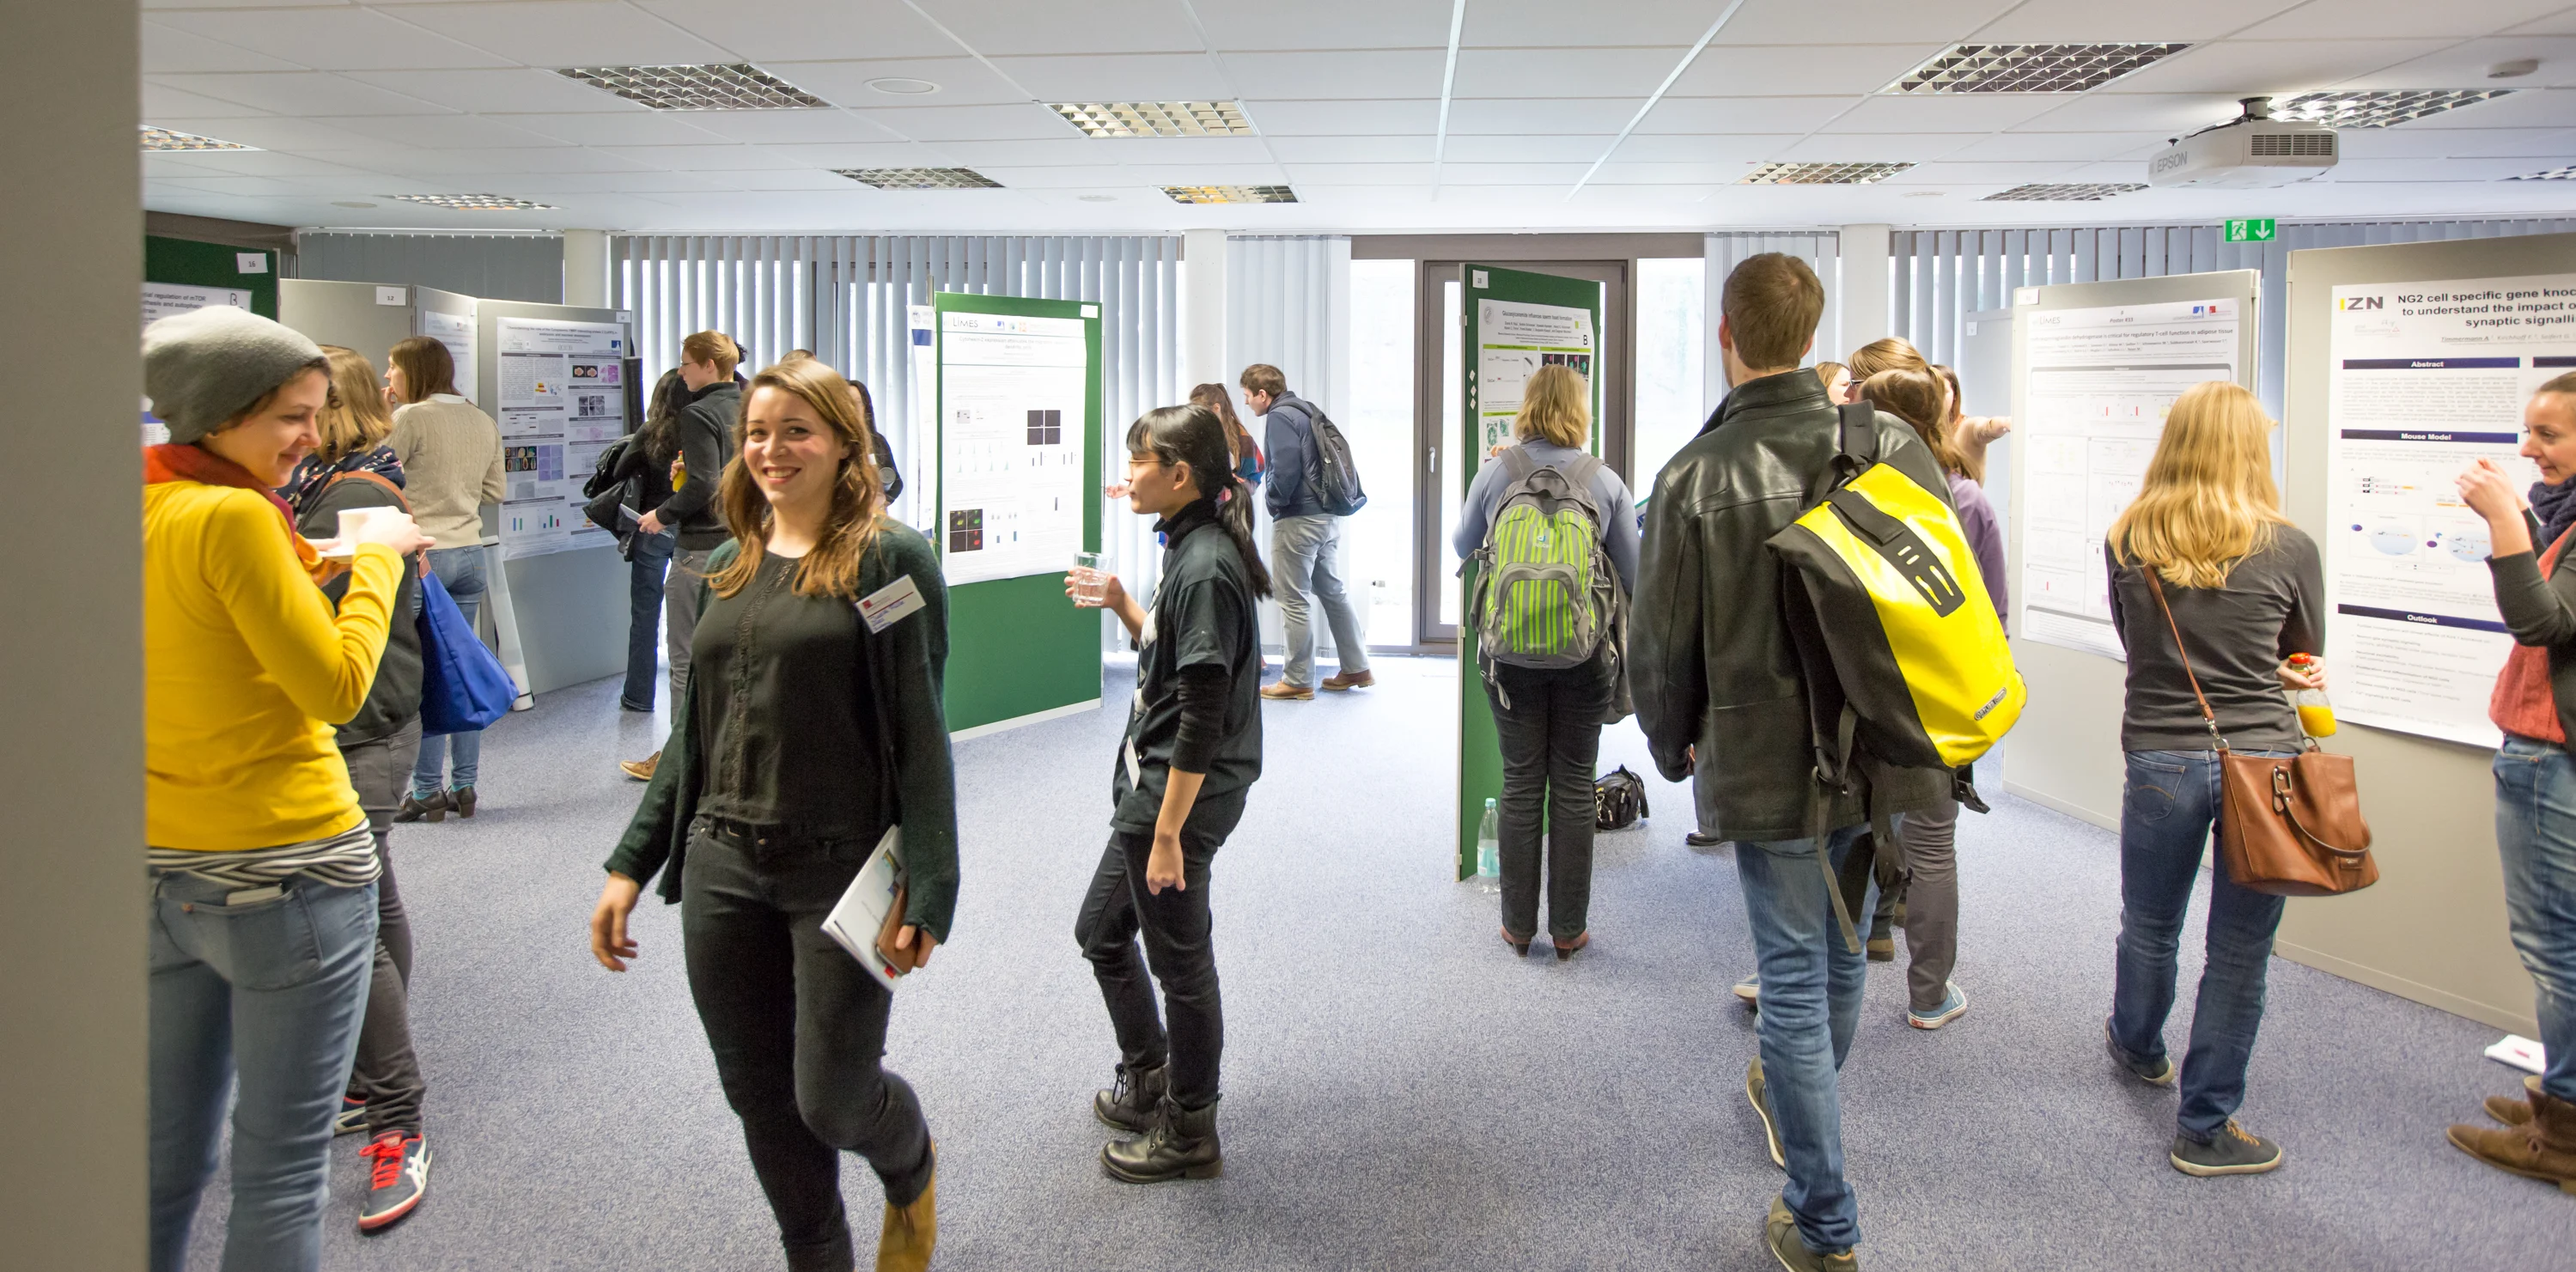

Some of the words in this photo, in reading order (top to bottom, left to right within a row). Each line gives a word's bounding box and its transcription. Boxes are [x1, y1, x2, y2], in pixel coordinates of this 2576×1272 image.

[2157, 150, 2189, 173] EPSON
[229, 292, 238, 306] B
[2340, 295, 2384, 311] IZN
[2397, 294, 2424, 304] NG2
[2427, 293, 2449, 303] cell
[2451, 290, 2502, 303] specific
[2506, 289, 2539, 301] gene
[2402, 307, 2414, 316] to
[2417, 304, 2489, 316] understand
[2493, 303, 2513, 313] the
[2517, 301, 2564, 313] impact
[2465, 315, 2521, 329] synaptic
[2524, 314, 2576, 326] signalli
[1582, 334, 1588, 345] B
[2401, 432, 2427, 441] Mouse
[2427, 433, 2451, 441] Model
[2407, 613, 2438, 624] Outlook
